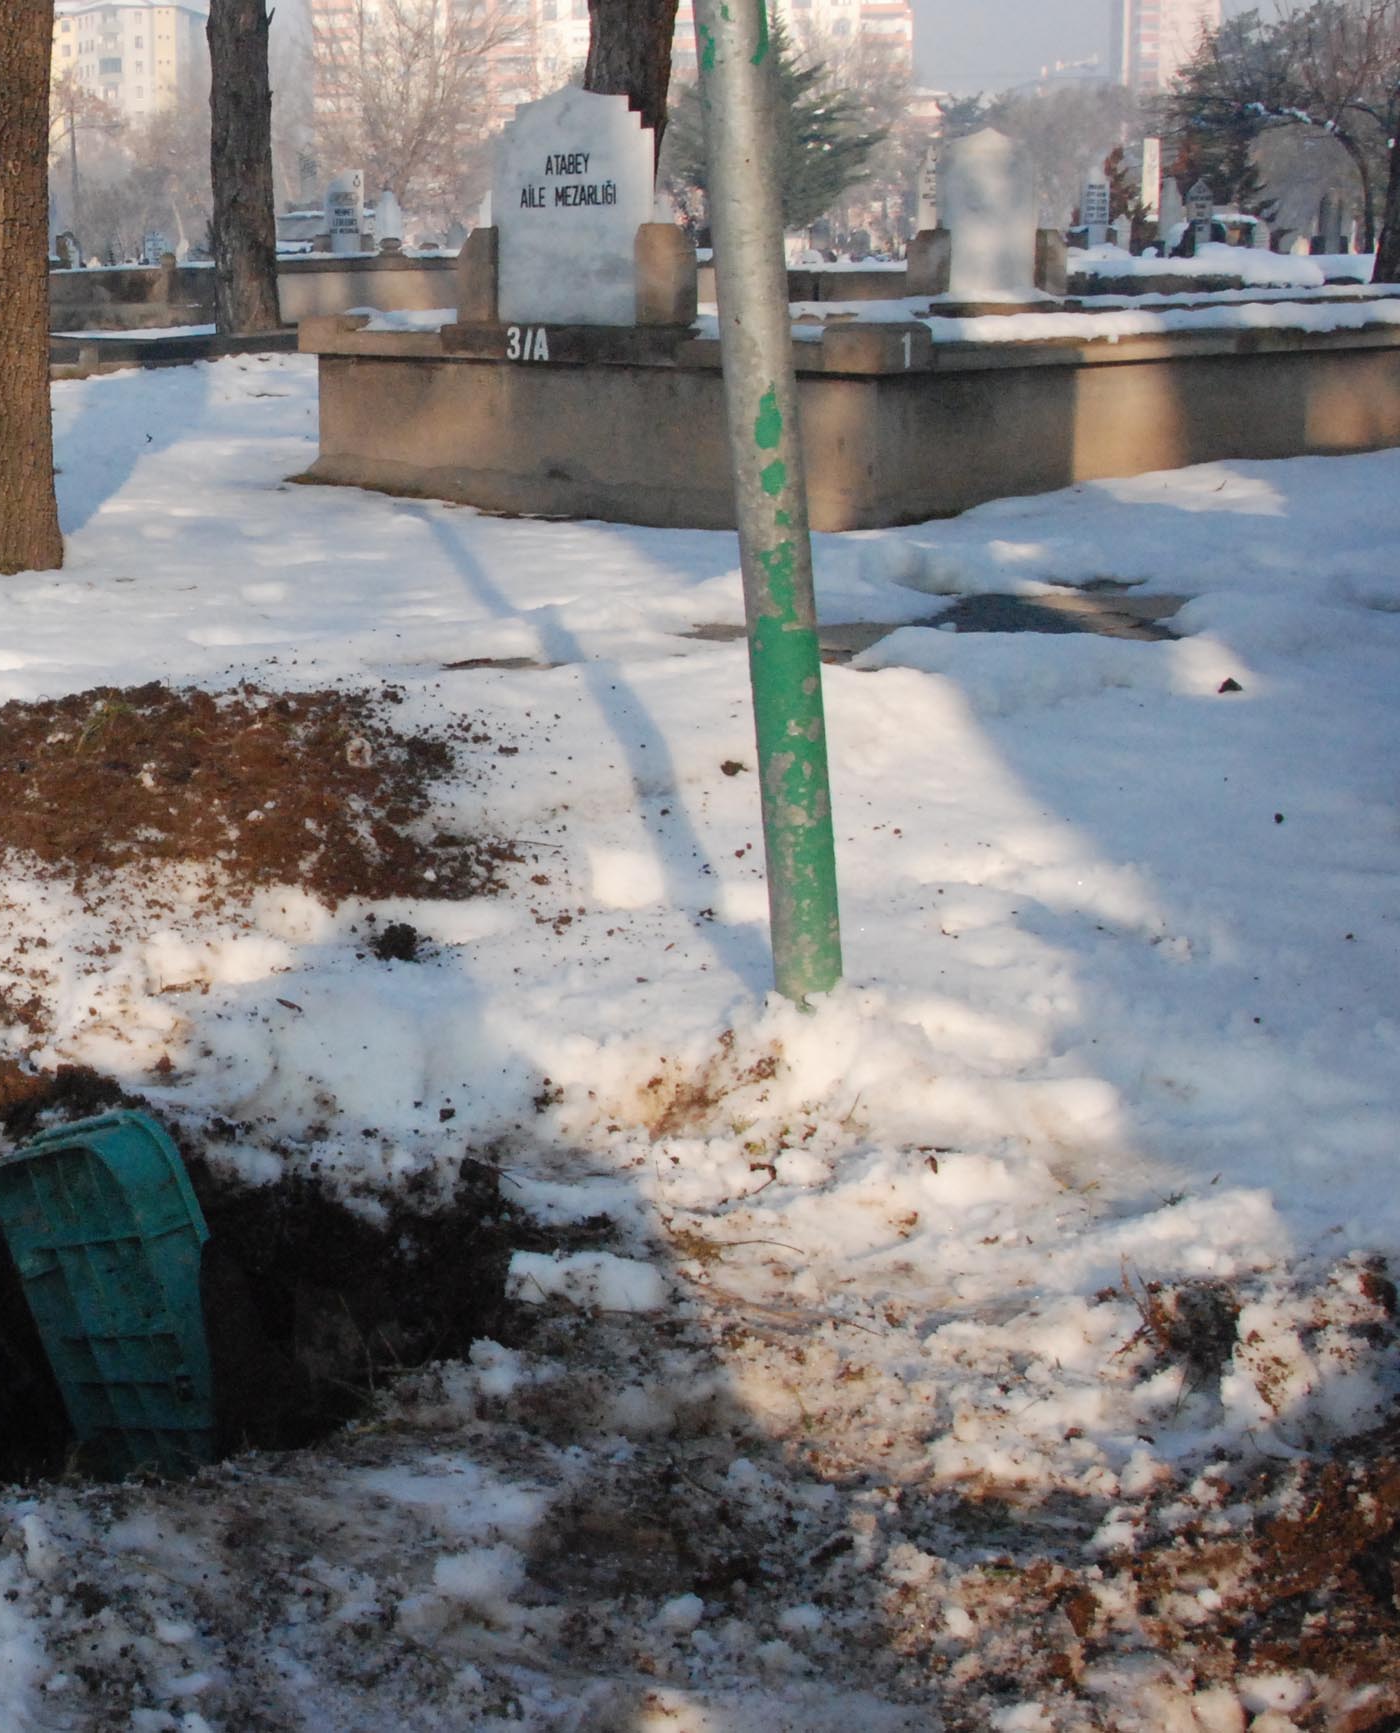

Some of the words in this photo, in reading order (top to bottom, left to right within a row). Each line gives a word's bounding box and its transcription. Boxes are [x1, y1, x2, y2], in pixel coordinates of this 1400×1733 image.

[545, 153, 590, 176] ATABEY
[520, 184, 546, 209] AİLE
[555, 180, 616, 207] MEZARLIĞI
[506, 326, 549, 361] 3/A
